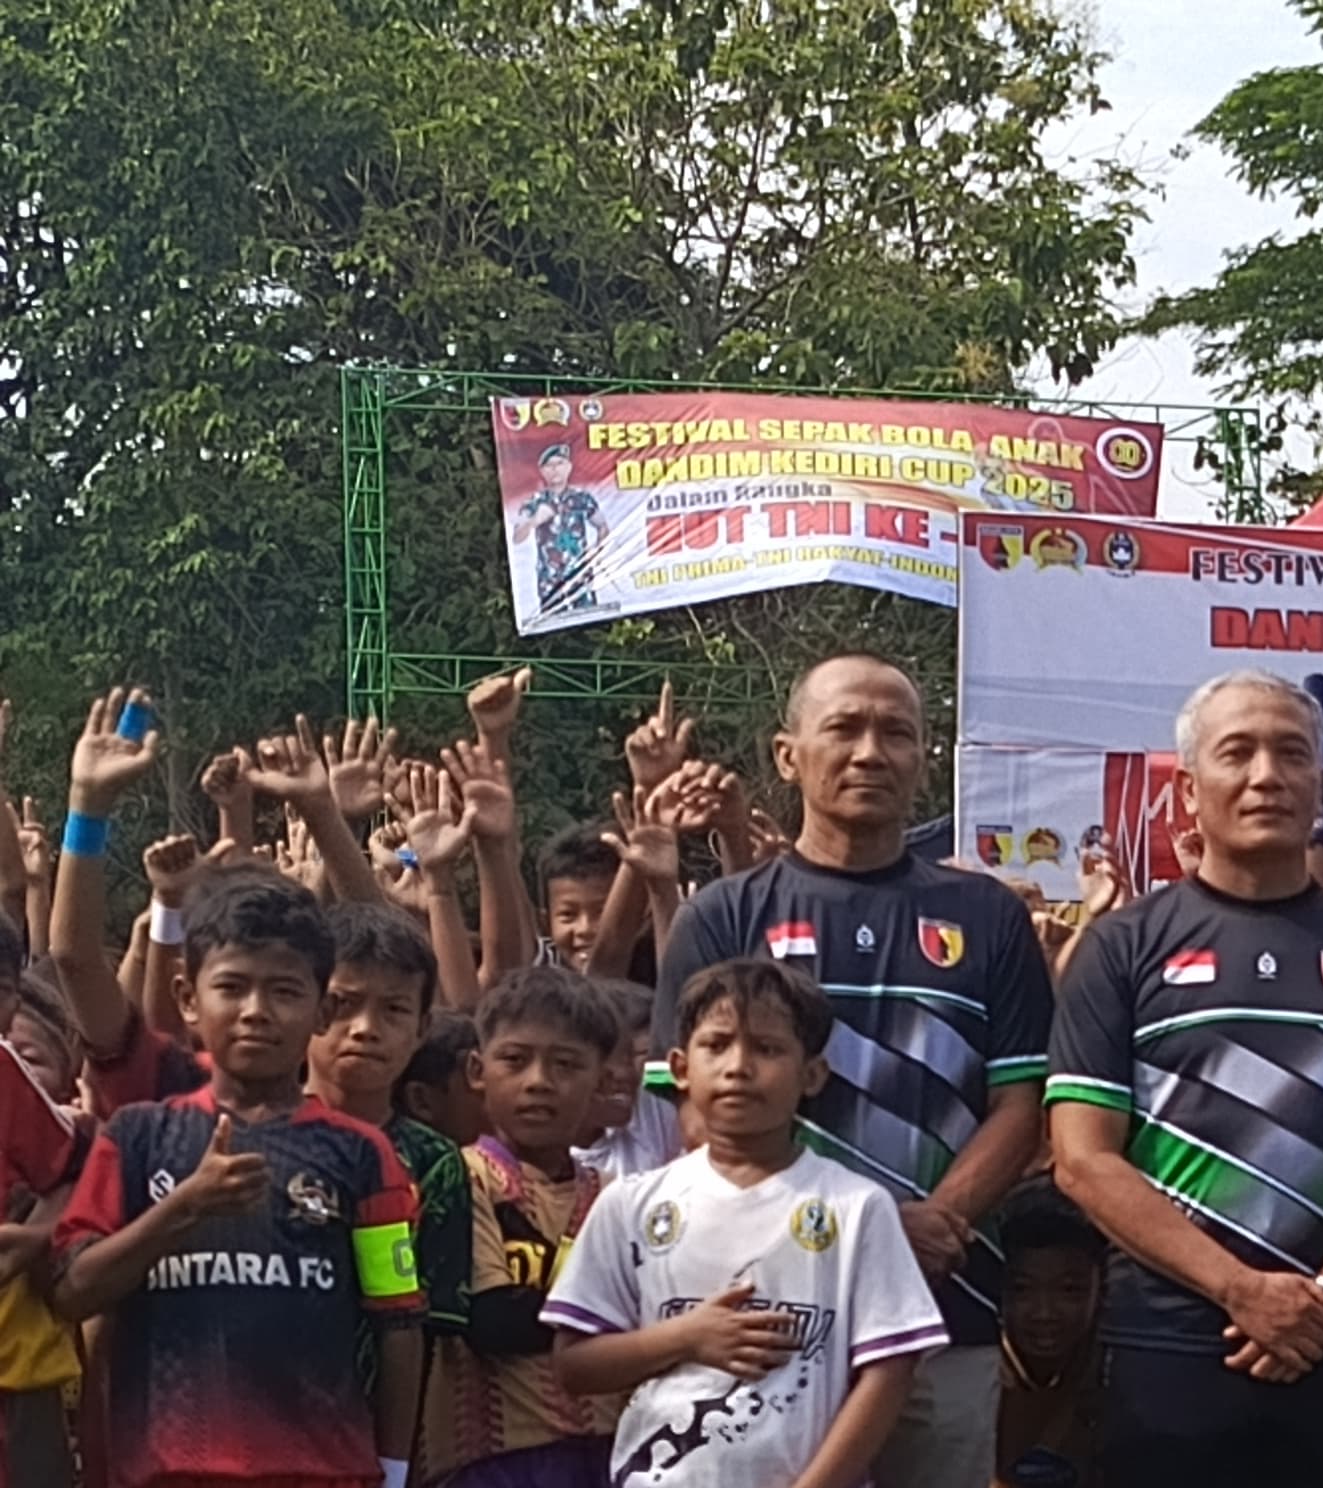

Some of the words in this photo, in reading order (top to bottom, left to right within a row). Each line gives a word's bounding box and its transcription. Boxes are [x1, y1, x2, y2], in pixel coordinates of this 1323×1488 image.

[588, 418, 751, 450] FESTIVAL
[759, 418, 873, 445] SEPAK
[881, 423, 974, 453] BOLA
[990, 434, 1085, 471] ANAK
[615, 450, 761, 490] DANDIM
[768, 449, 892, 480] KEDIRI
[900, 455, 975, 489] CUP
[980, 458, 1076, 511] 2025
[646, 485, 728, 513] dalam
[645, 506, 753, 557] HUT
[759, 502, 852, 539] TNI
[863, 503, 931, 549] KE
[299, 1256, 335, 1290] FC
